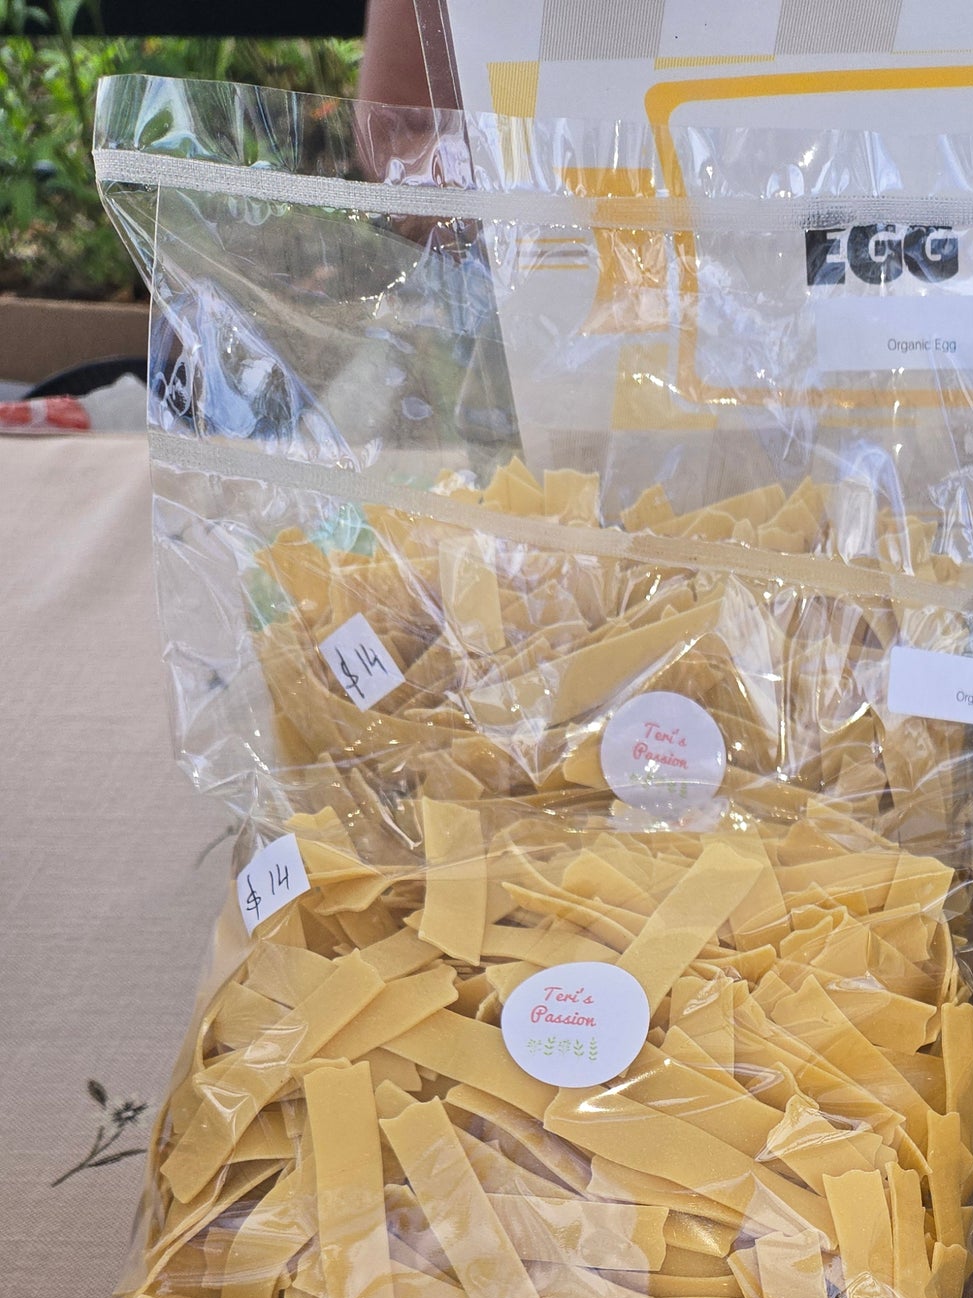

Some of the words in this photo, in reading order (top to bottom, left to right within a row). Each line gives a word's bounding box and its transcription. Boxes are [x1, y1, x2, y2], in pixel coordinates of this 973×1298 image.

[804, 207, 960, 286] EGG
[887, 337, 932, 353] Organic
[934, 338, 957, 354] Egg
[334, 643, 388, 699] $14
[643, 721, 688, 748] Teri's
[632, 741, 689, 770] Passion
[544, 986, 595, 1005] Teri's
[530, 1004, 597, 1027] Passion
